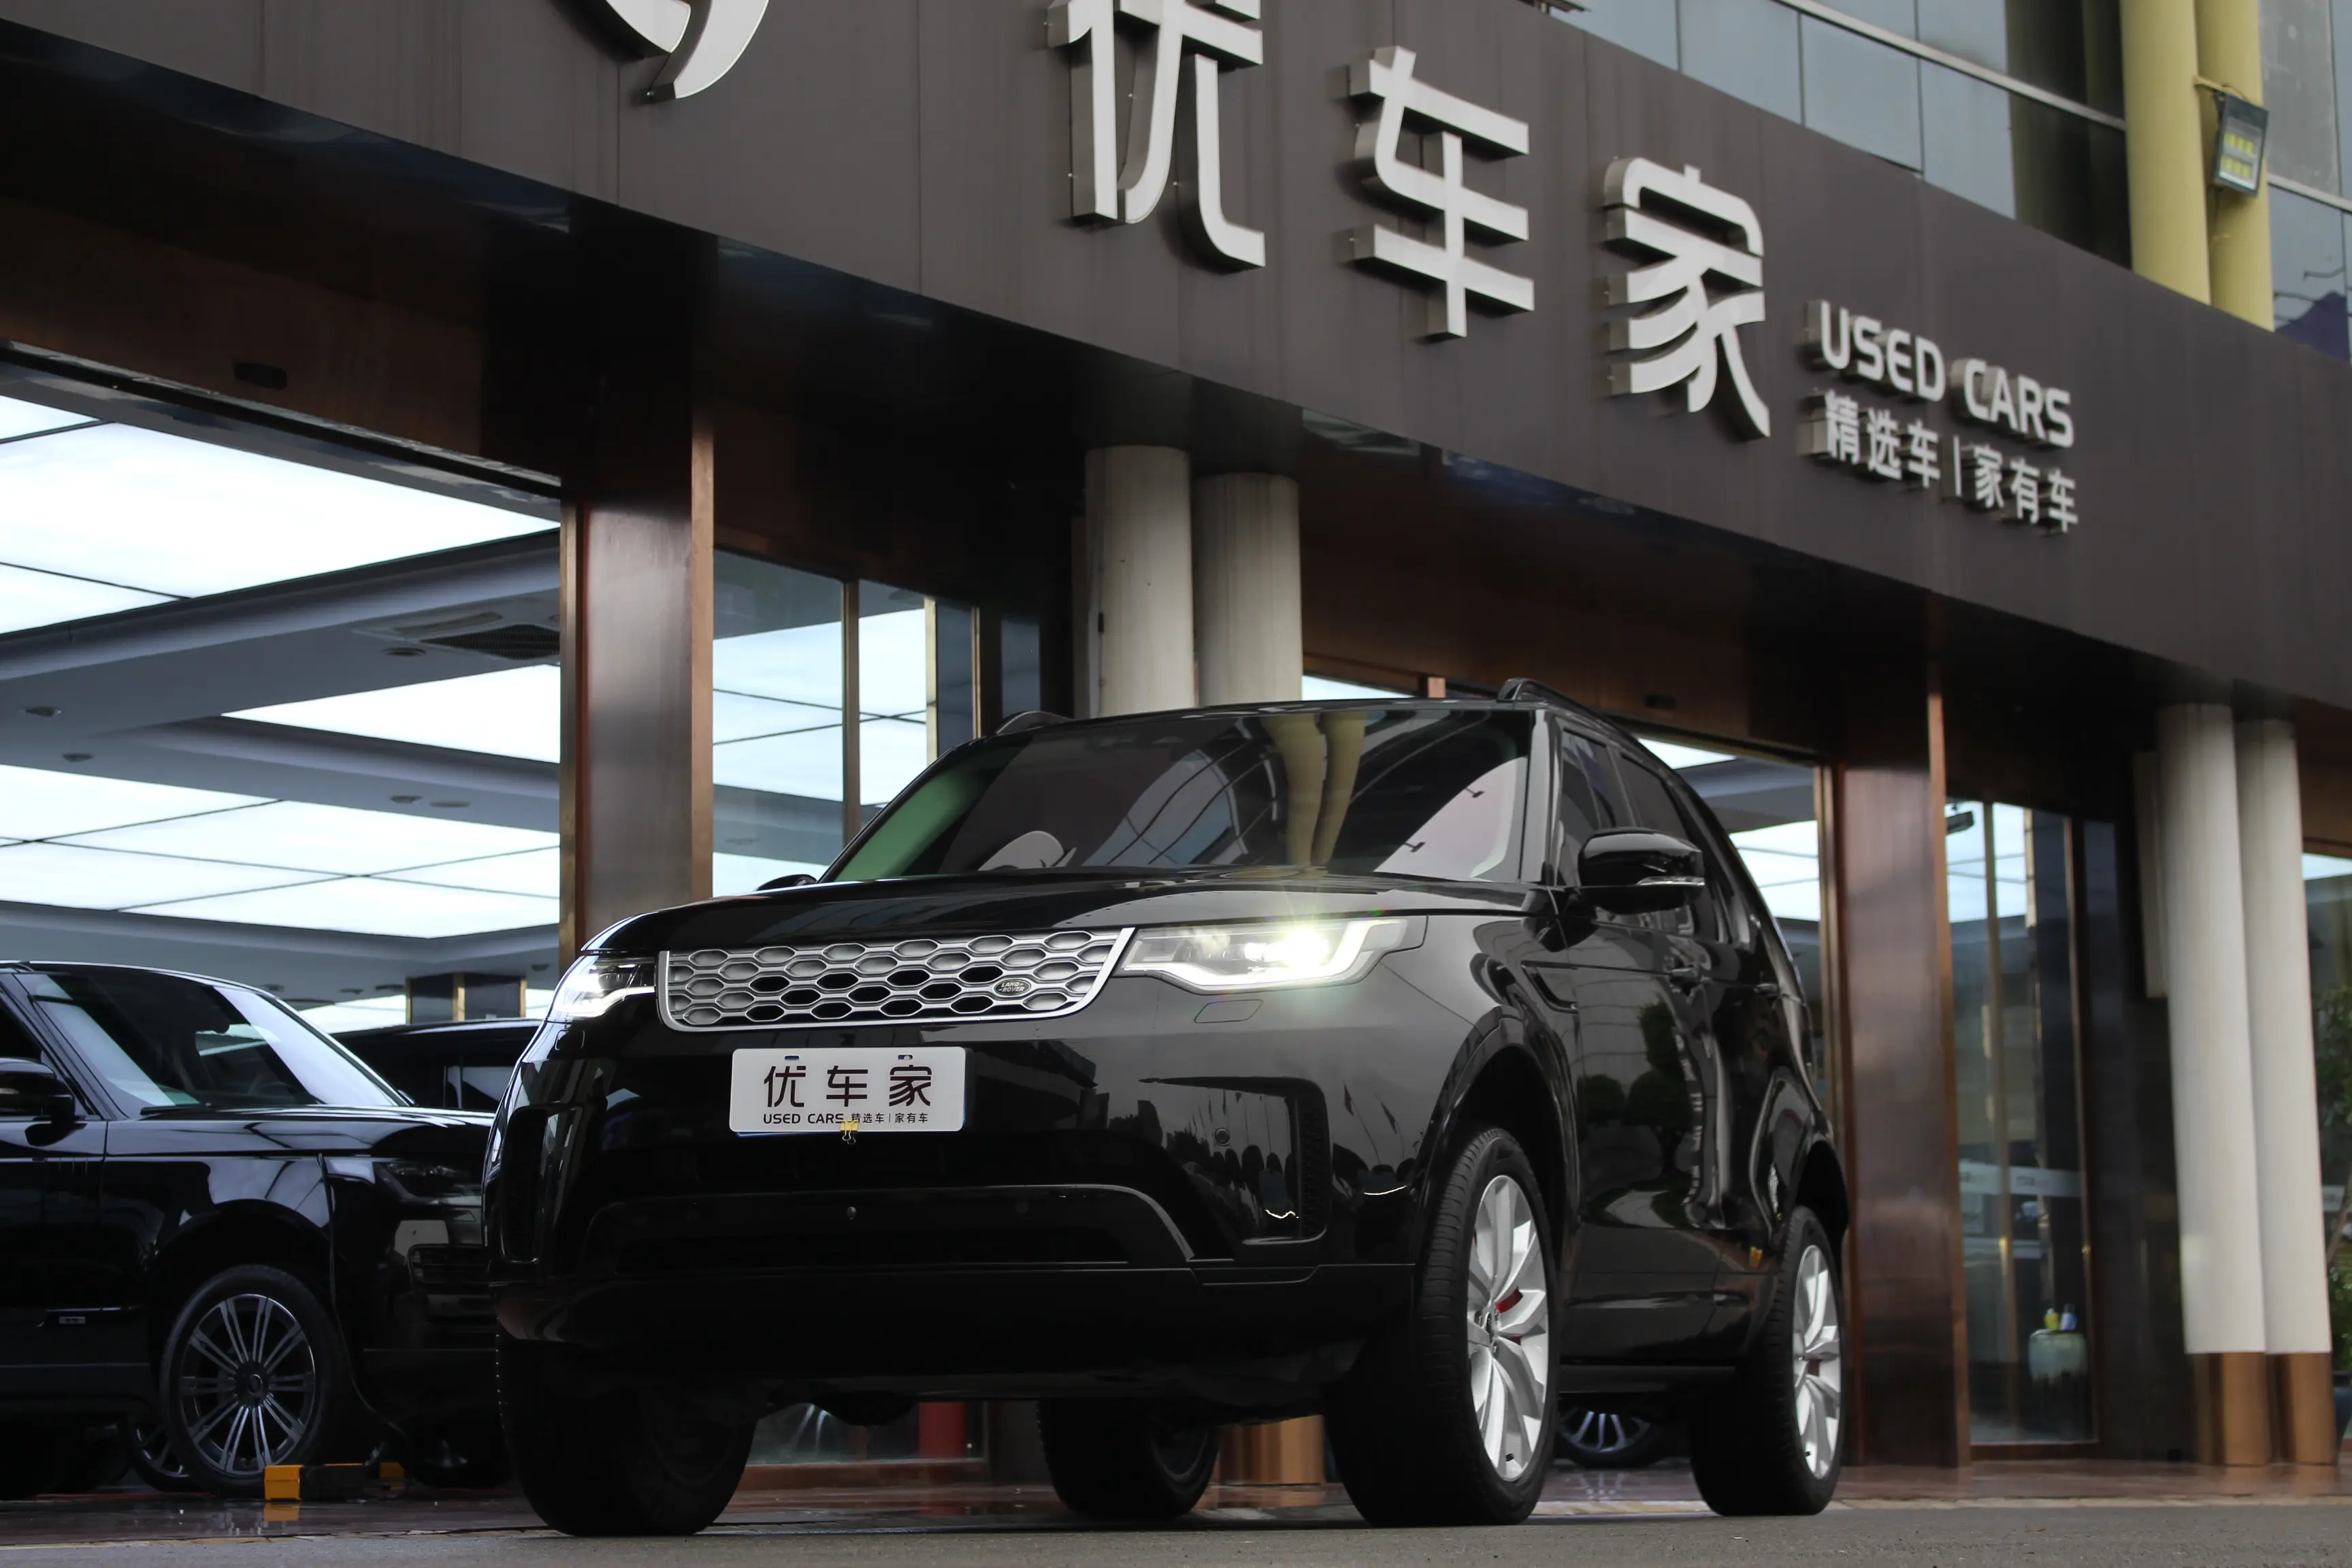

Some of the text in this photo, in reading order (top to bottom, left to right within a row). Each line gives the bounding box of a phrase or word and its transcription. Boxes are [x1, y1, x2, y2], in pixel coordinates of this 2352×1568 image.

[1068, 0, 1769, 439] 优车家
[1820, 299, 2075, 448] USED CARS
[763, 1113, 845, 1124] USED CARS
[764, 1064, 932, 1108] 优车家
